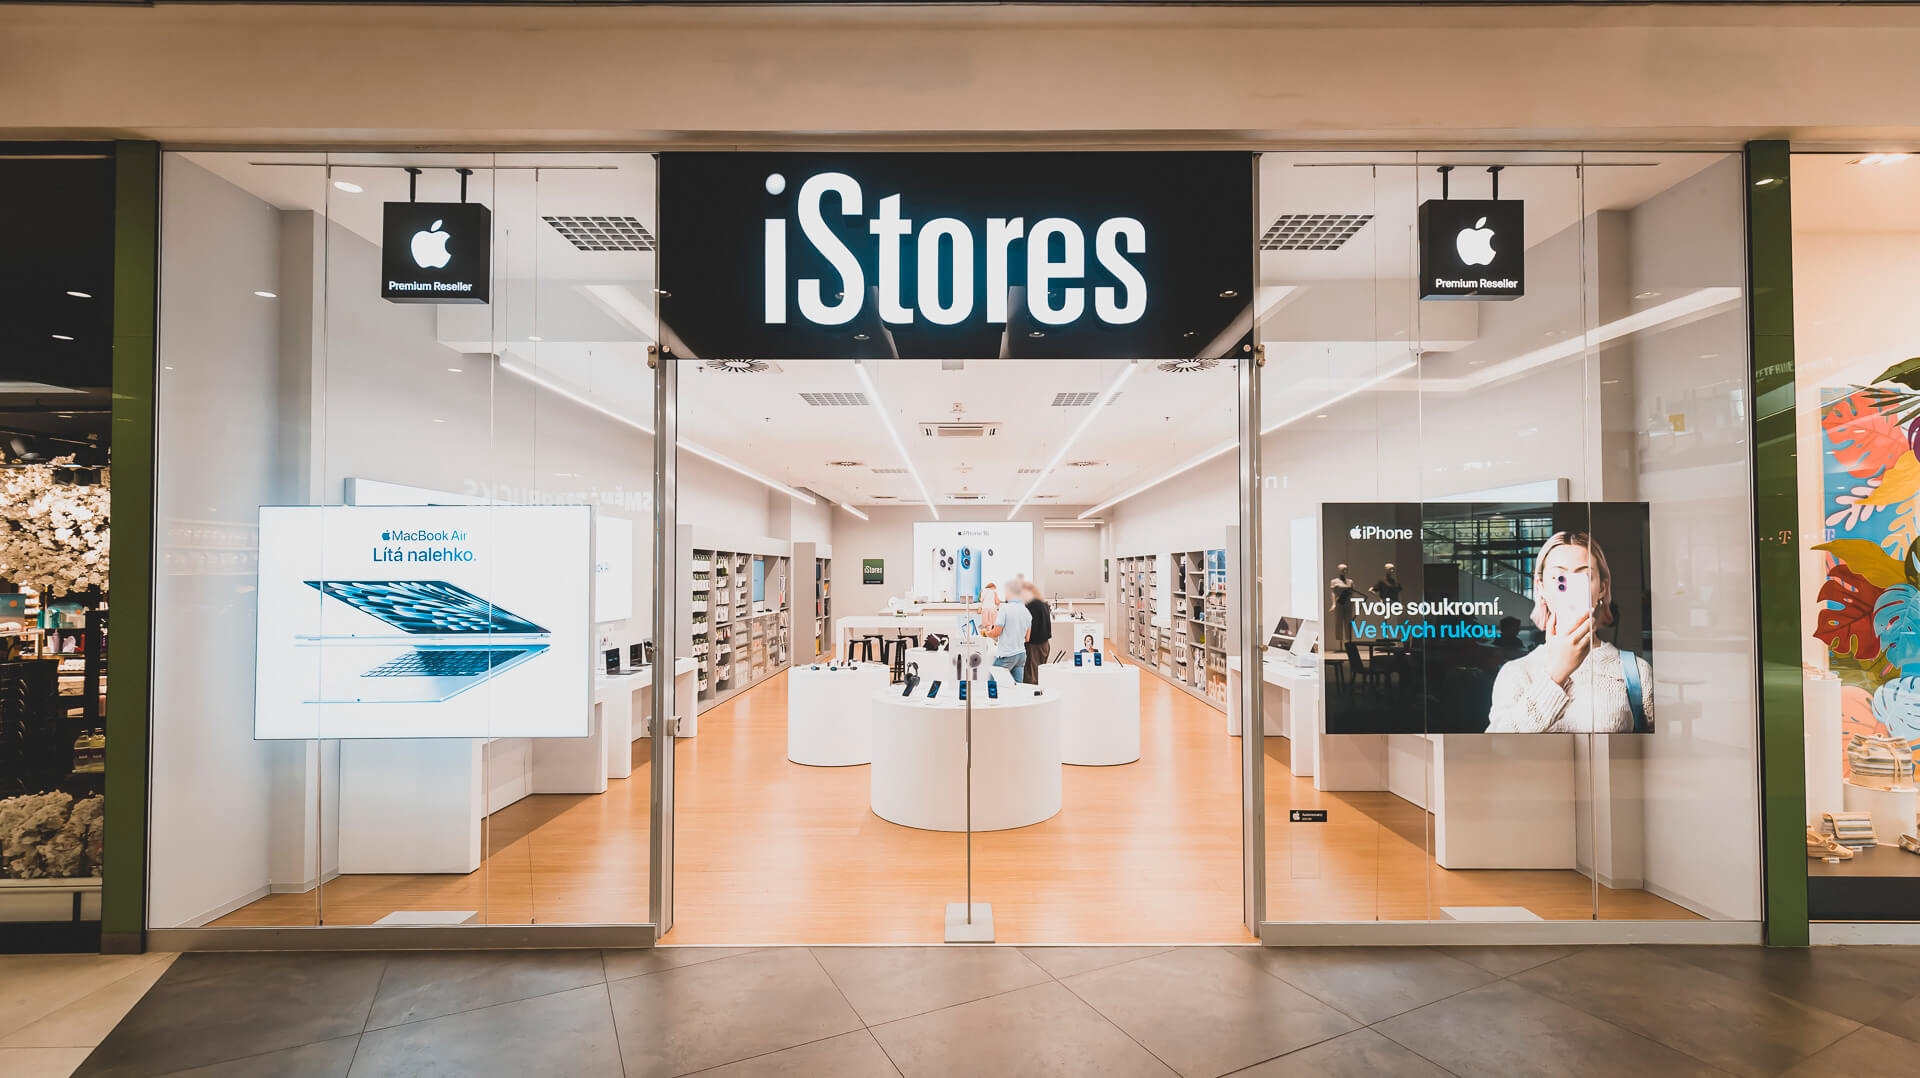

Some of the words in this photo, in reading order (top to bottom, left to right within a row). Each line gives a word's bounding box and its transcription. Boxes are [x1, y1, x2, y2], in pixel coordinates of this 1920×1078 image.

[765, 172, 1147, 325] iStores
[388, 281, 432, 291] Premium
[433, 281, 472, 291] Reseller
[1435, 278, 1478, 289] Premium
[1479, 278, 1518, 289] Reseller
[392, 530, 448, 541] MacBook
[451, 530, 467, 541] Air
[1362, 526, 1413, 540] iPhone
[373, 547, 403, 562] Lítá
[407, 547, 477, 562] nalehko.
[1350, 597, 1403, 619] Tvoje
[1407, 597, 1504, 616] soukromí.
[1351, 620, 1377, 639] Ve
[1380, 620, 1436, 643] tvých
[1440, 620, 1502, 639] rukou.
